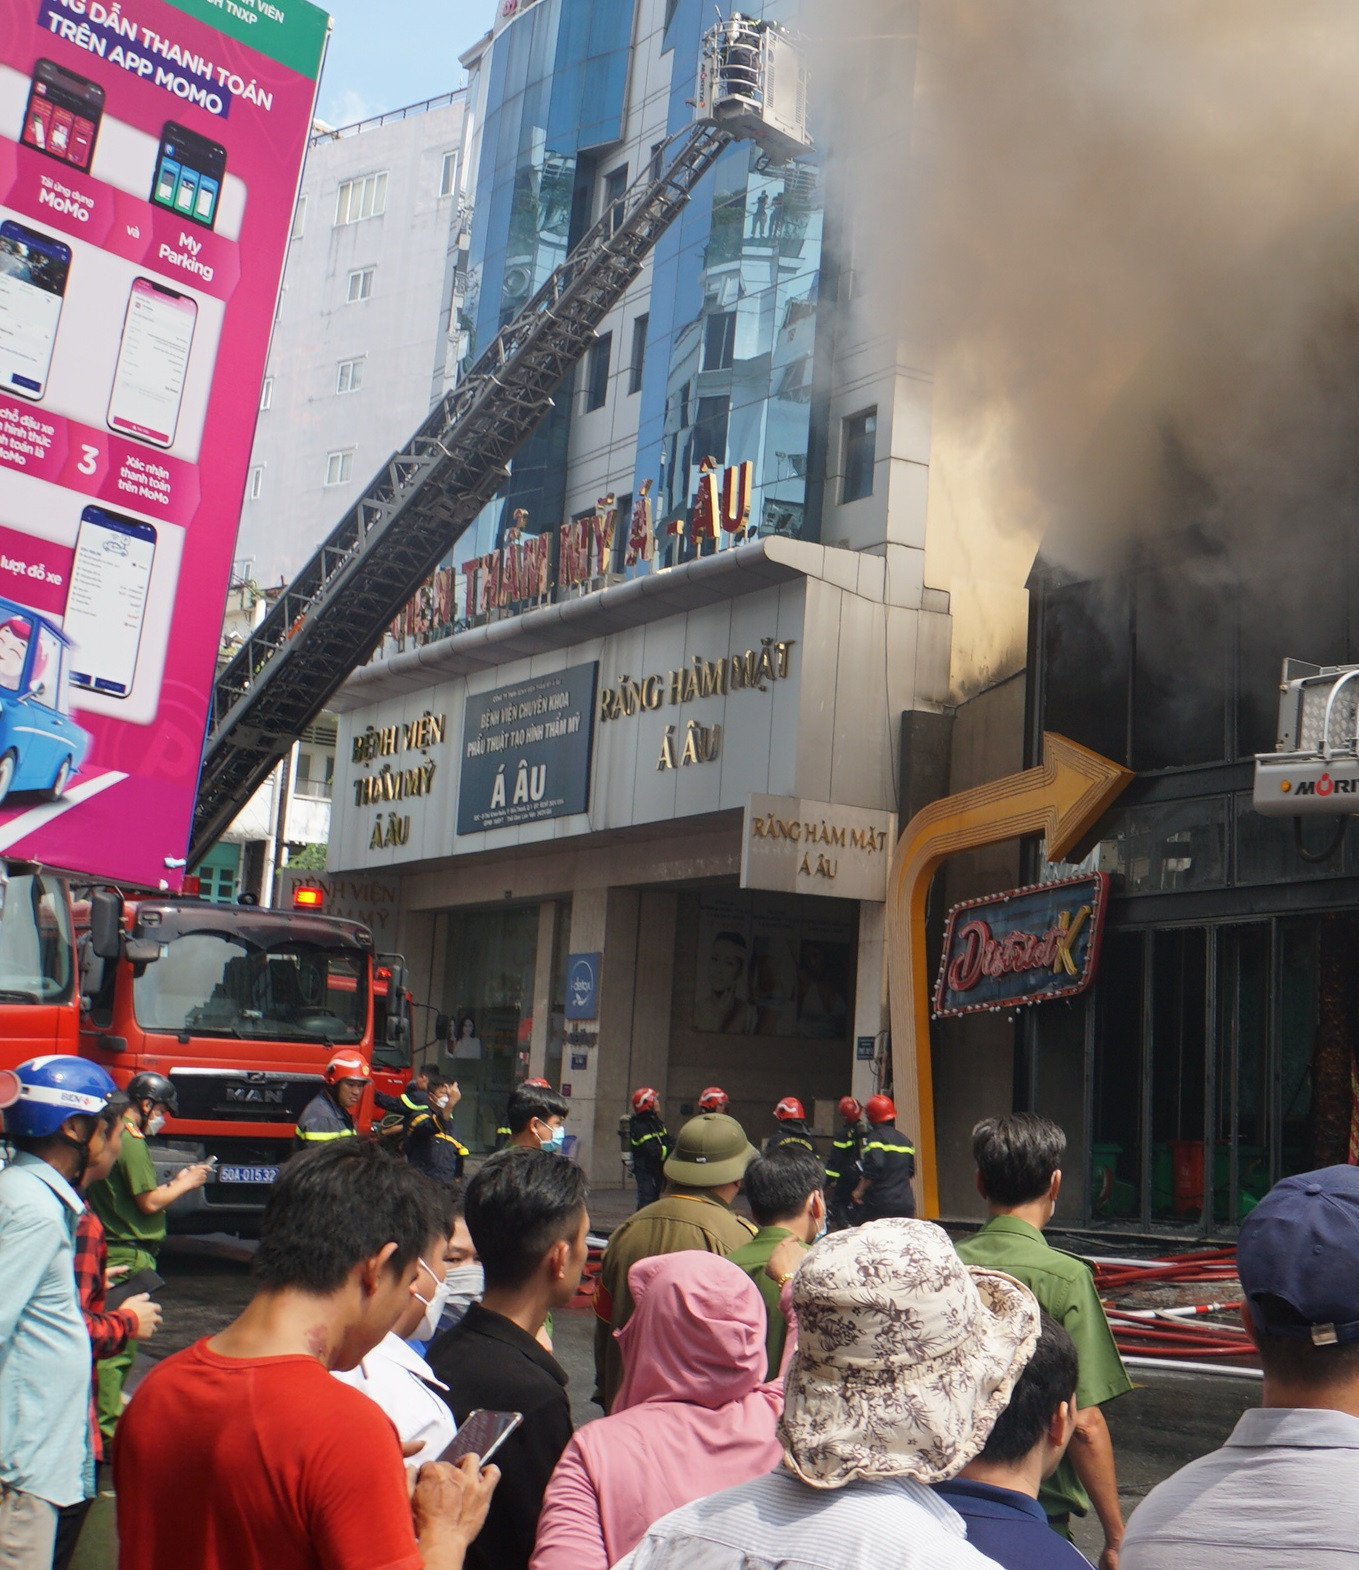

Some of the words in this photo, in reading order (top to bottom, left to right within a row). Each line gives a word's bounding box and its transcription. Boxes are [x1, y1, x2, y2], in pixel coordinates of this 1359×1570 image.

[225, 0, 258, 24] TNXP
[48, 11, 107, 58] TRÊN
[108, 45, 154, 77] APP
[155, 66, 223, 115] MOMO
[89, 2, 138, 42] DẪN
[141, 27, 213, 81] THANH
[217, 66, 273, 111] TOÁN
[126, 224, 140, 239] và
[179, 231, 202, 256] My
[159, 243, 214, 282] Parking
[41, 423, 55, 436] xe
[10, 437, 33, 455] toán
[77, 444, 99, 475] 3
[118, 478, 138, 495] trên
[120, 466, 148, 485] thanh
[148, 476, 171, 493] toán
[690, 455, 753, 546] ÂU
[46, 572, 62, 585] xe
[600, 674, 664, 722] RĂNG
[668, 655, 728, 705] HÀM
[730, 637, 796, 692] MẶT
[548, 691, 570, 712] KHOA
[525, 723, 545, 743] HÌNH
[656, 724, 678, 771] Á
[680, 719, 723, 767] ÂU
[490, 763, 507, 809] Á
[512, 758, 547, 805] ÂU
[752, 812, 801, 843] RĂNG
[804, 820, 846, 848] HÀM
[850, 825, 887, 855] MẶT
[798, 851, 811, 876] Á
[814, 853, 838, 879] ÂU
[1054, 905, 1092, 976] K
[226, 1087, 284, 1103] MAN
